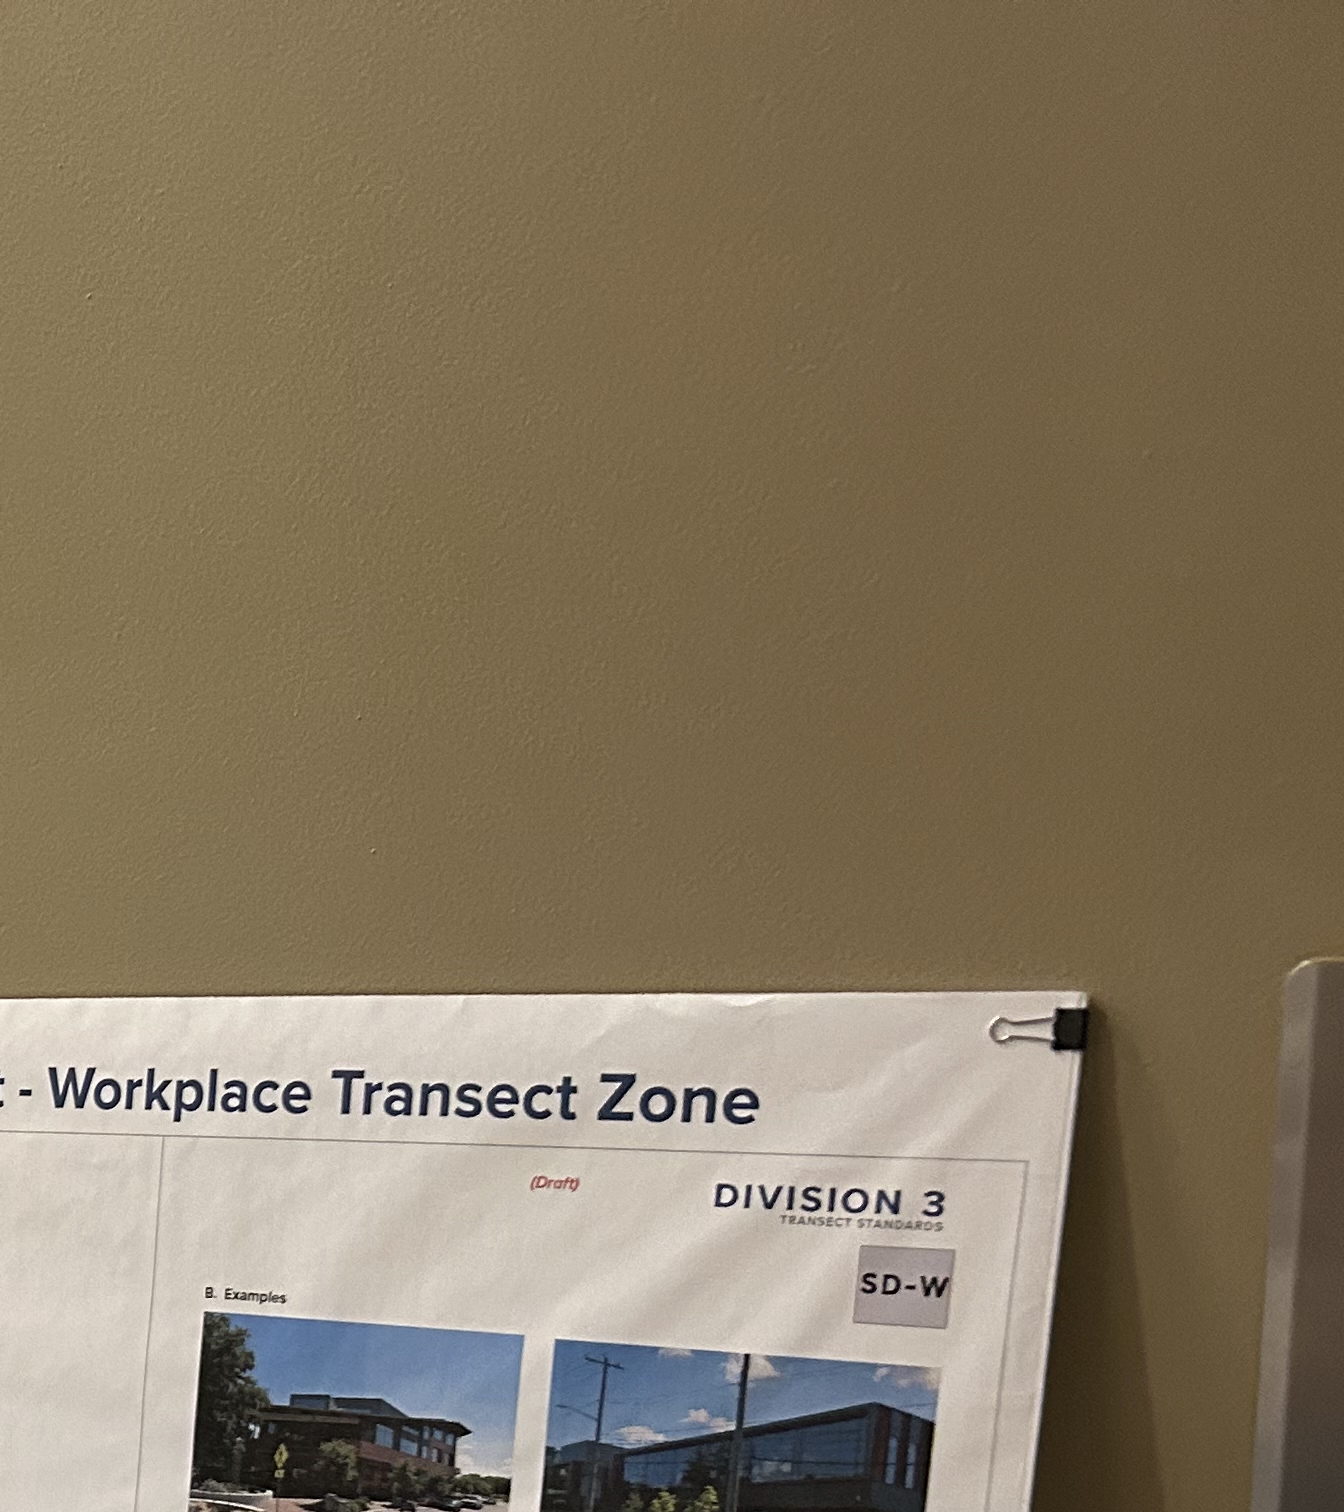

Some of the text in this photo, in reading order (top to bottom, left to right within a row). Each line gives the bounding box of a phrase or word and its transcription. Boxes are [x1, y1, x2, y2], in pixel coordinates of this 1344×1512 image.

[48, 1066, 312, 1123] Workplace
[332, 1069, 578, 1120] Transect
[596, 1073, 760, 1125] Zone
[530, 1176, 580, 1193] (Draft)
[714, 1183, 946, 1217] DIVISION 3
[780, 1214, 944, 1233] TRANSECT STANDARDS
[204, 1286, 286, 1305] B. Examples
[860, 1273, 950, 1298] SD-W
